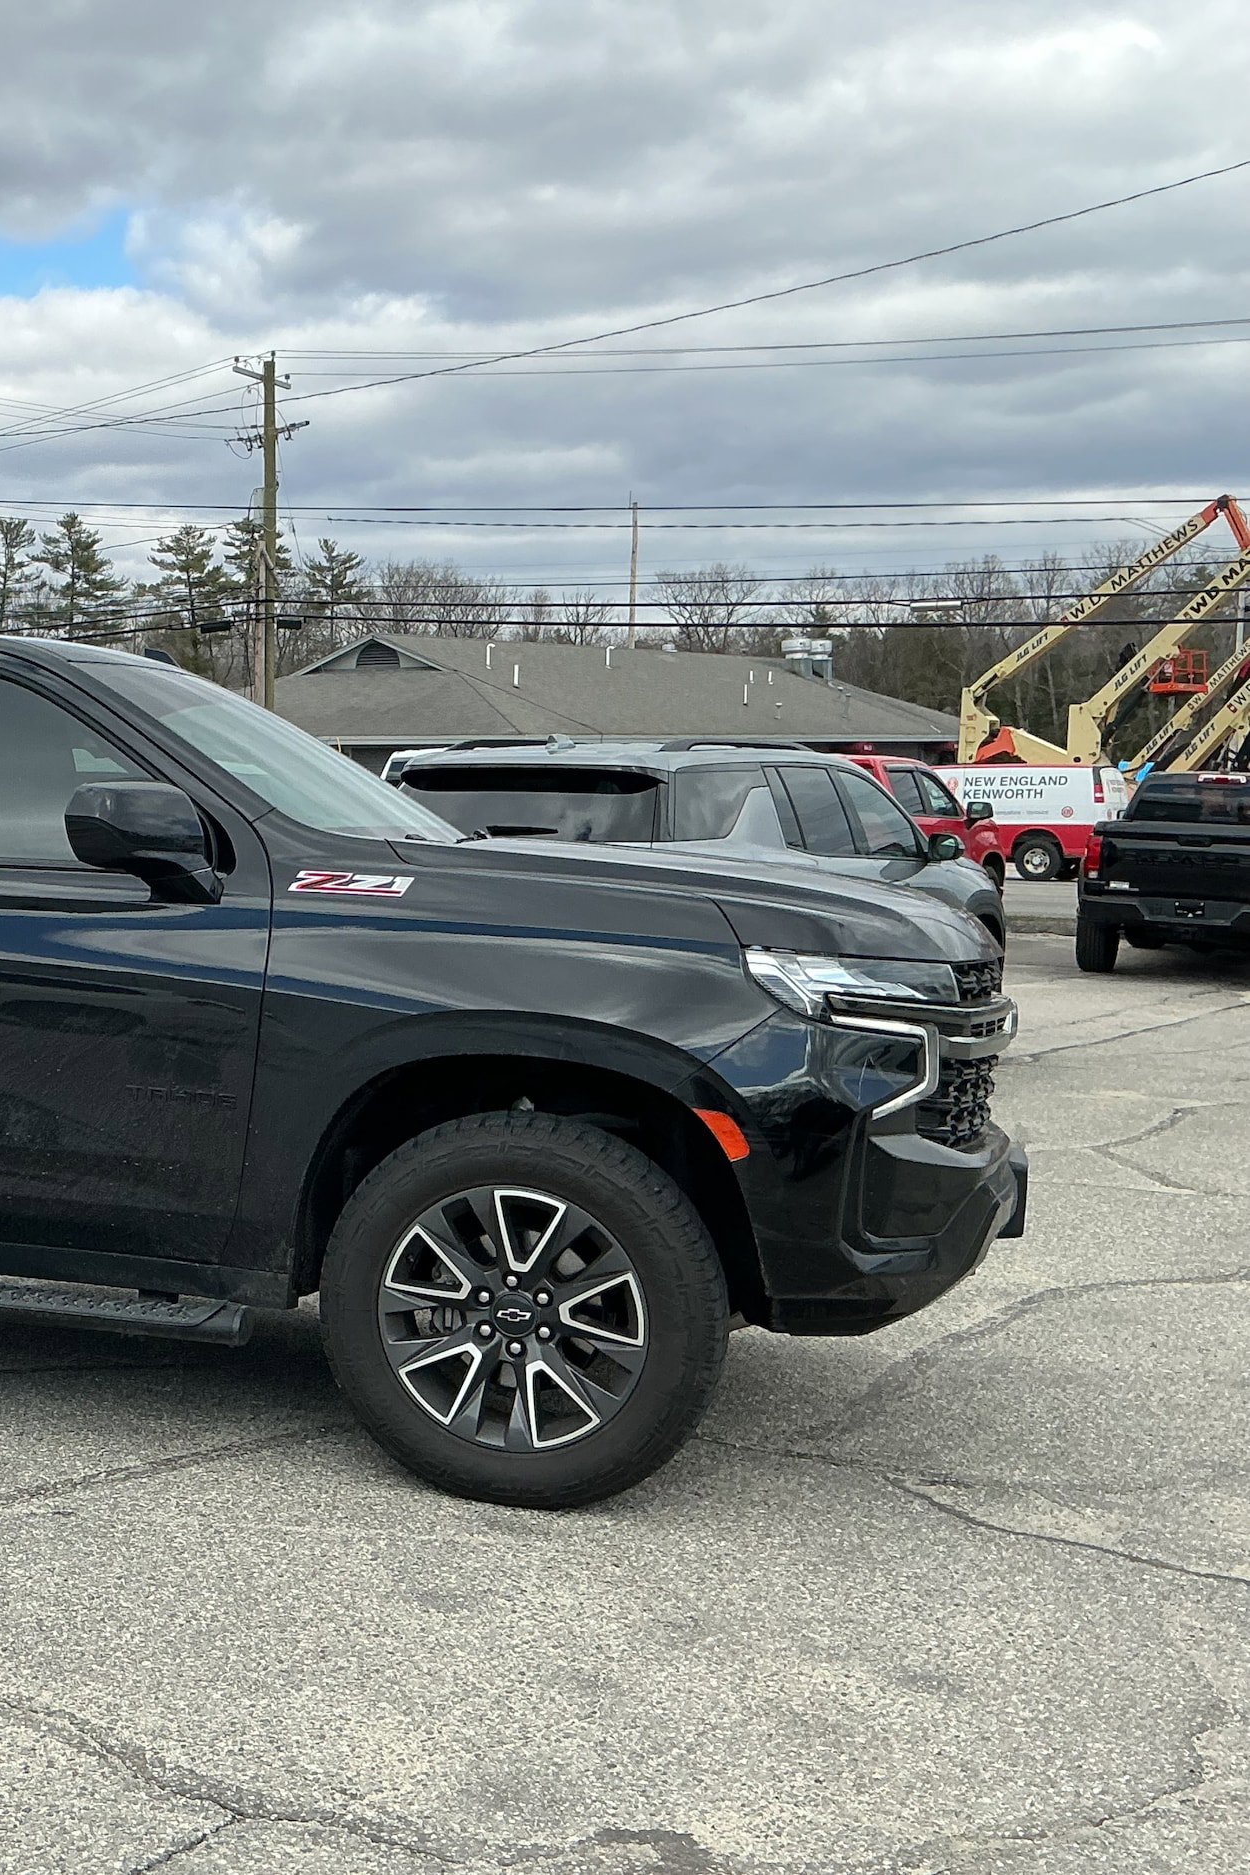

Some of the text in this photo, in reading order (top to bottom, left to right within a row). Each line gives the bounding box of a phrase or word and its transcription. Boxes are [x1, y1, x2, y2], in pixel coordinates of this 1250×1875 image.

[1110, 519, 1198, 591] MATTHEWS
[1015, 632, 1049, 663] JLG LIFT
[1114, 654, 1148, 691] JLG LIFT
[1145, 721, 1175, 755] JLG LIFT
[1184, 722, 1216, 761] JLG LIFT
[963, 788, 1043, 800] KENWORTH
[964, 775, 1068, 787] NEW ENGLAND
[287, 870, 415, 898] Z71
